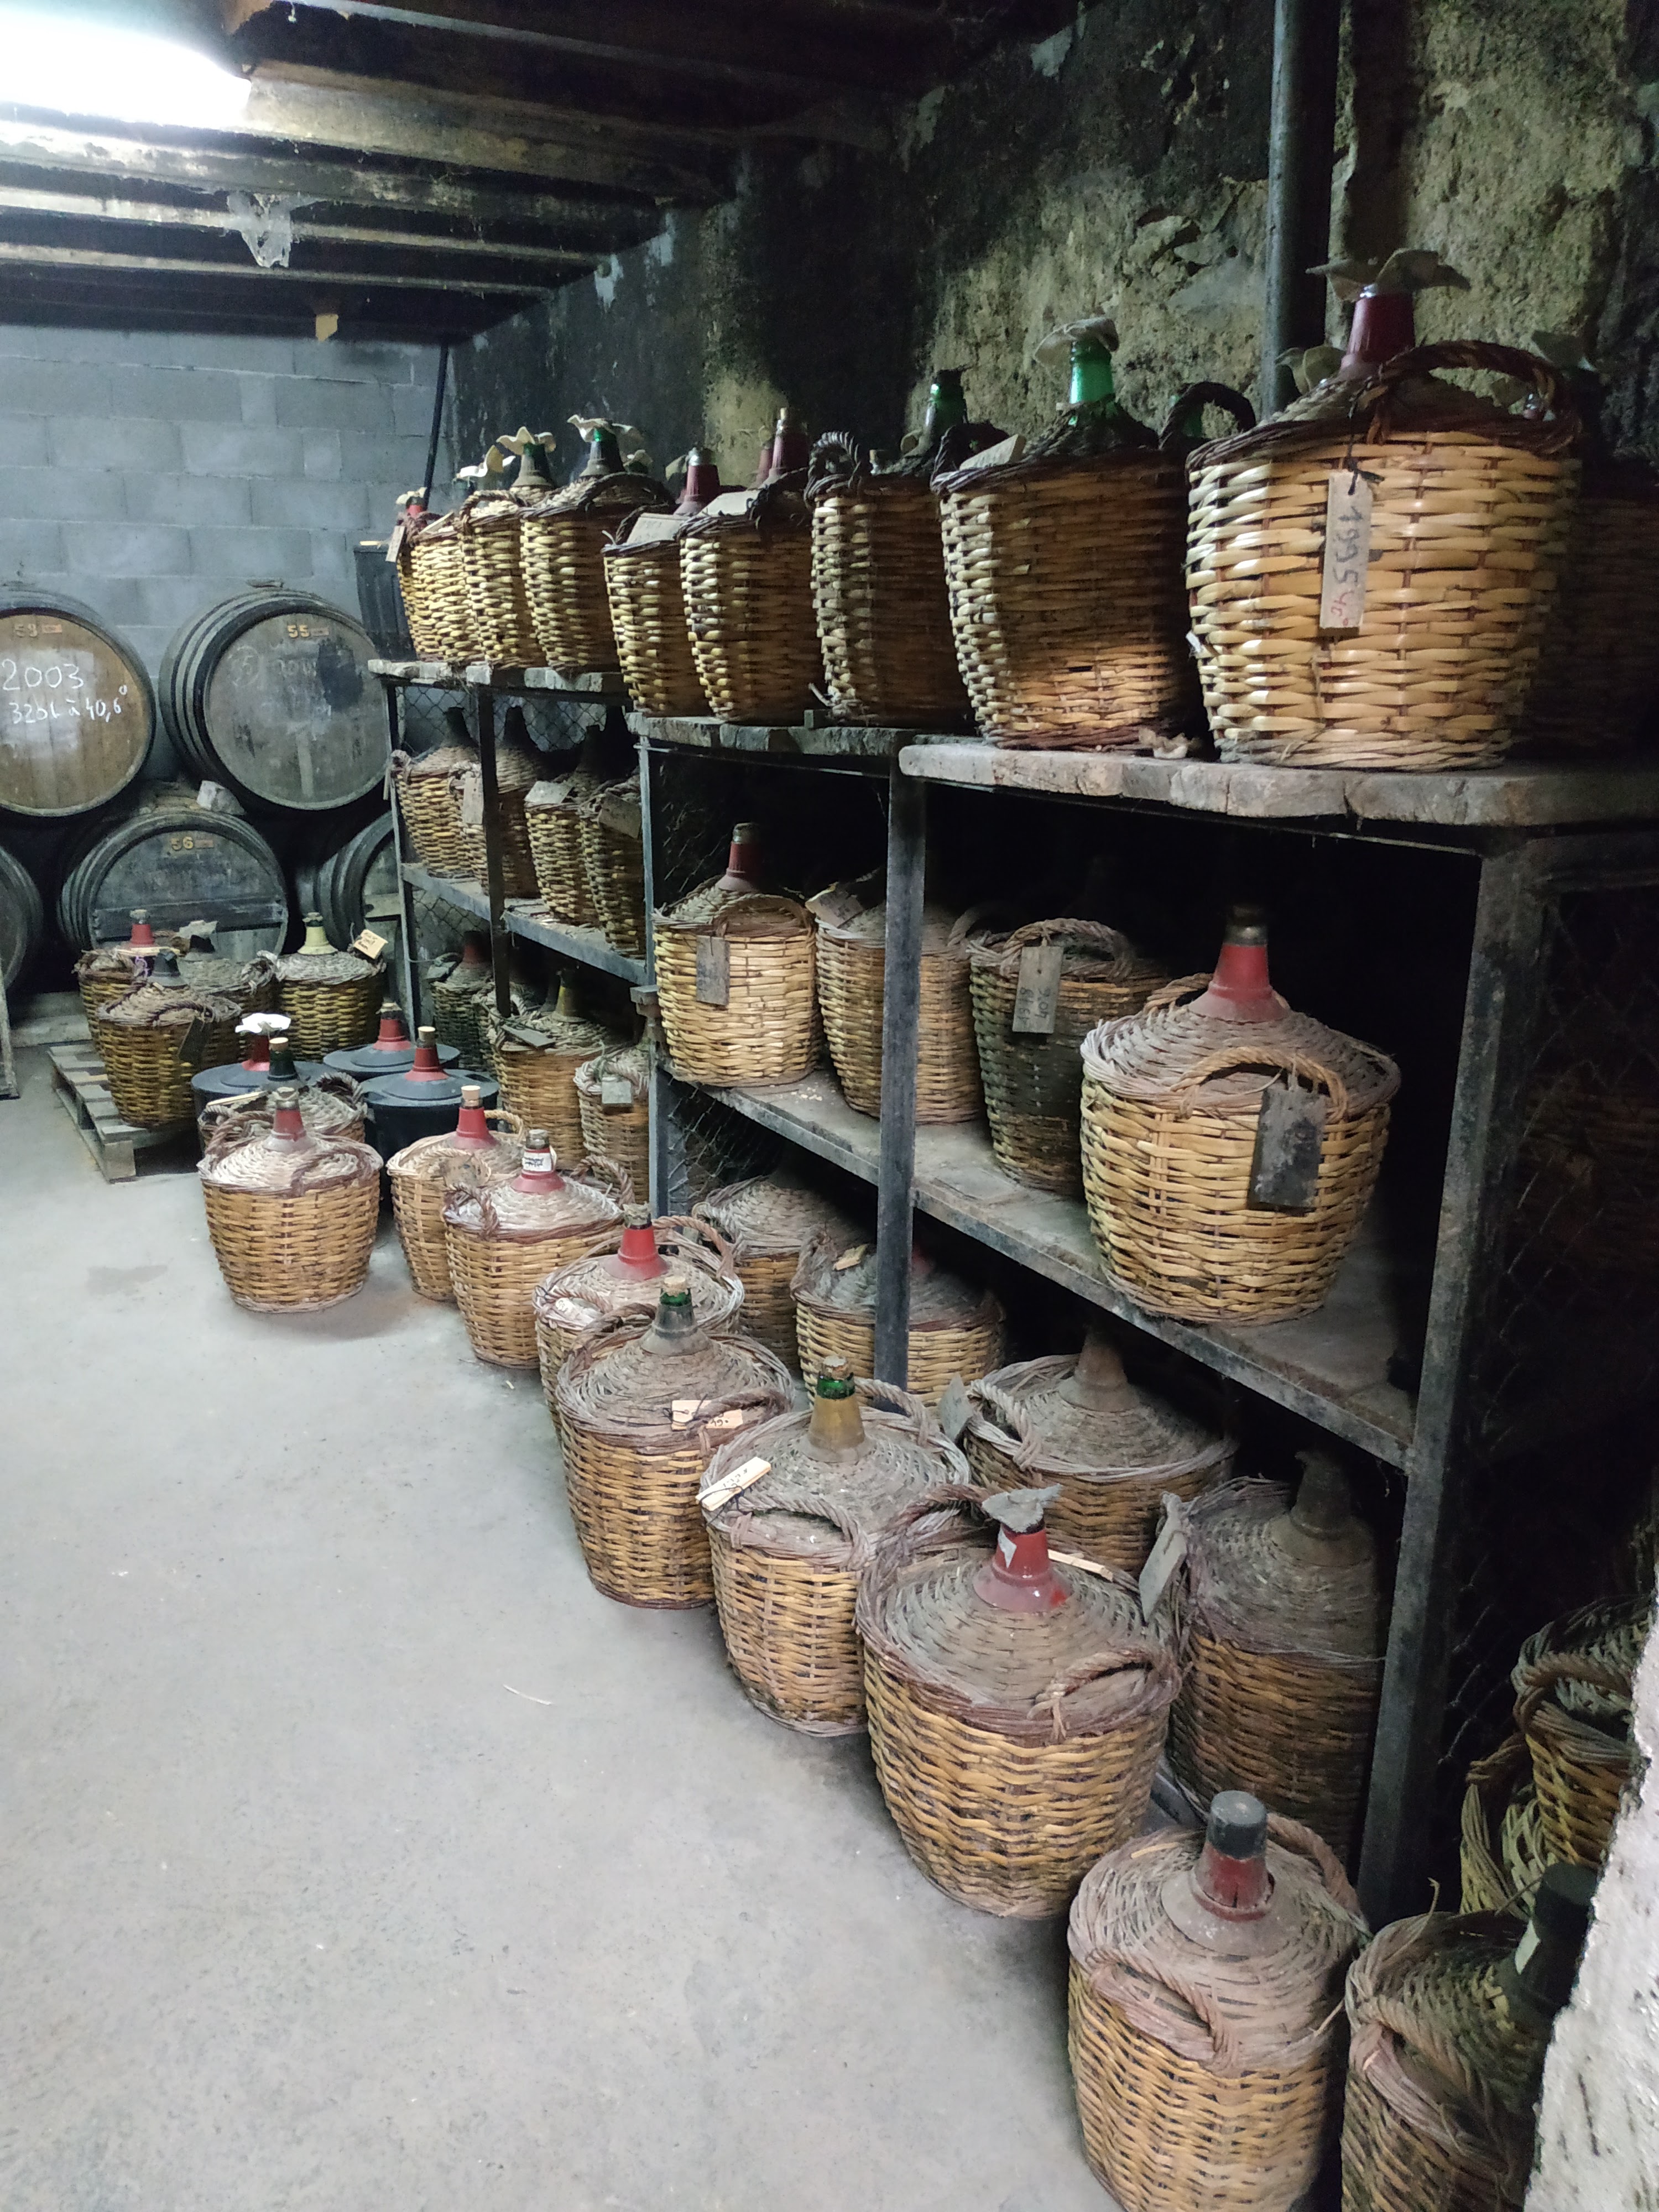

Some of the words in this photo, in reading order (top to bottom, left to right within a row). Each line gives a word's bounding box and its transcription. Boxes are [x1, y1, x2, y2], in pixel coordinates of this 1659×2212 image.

[287, 624, 310, 638] 55
[2, 658, 84, 690] 2003
[170, 836, 194, 851] 56
